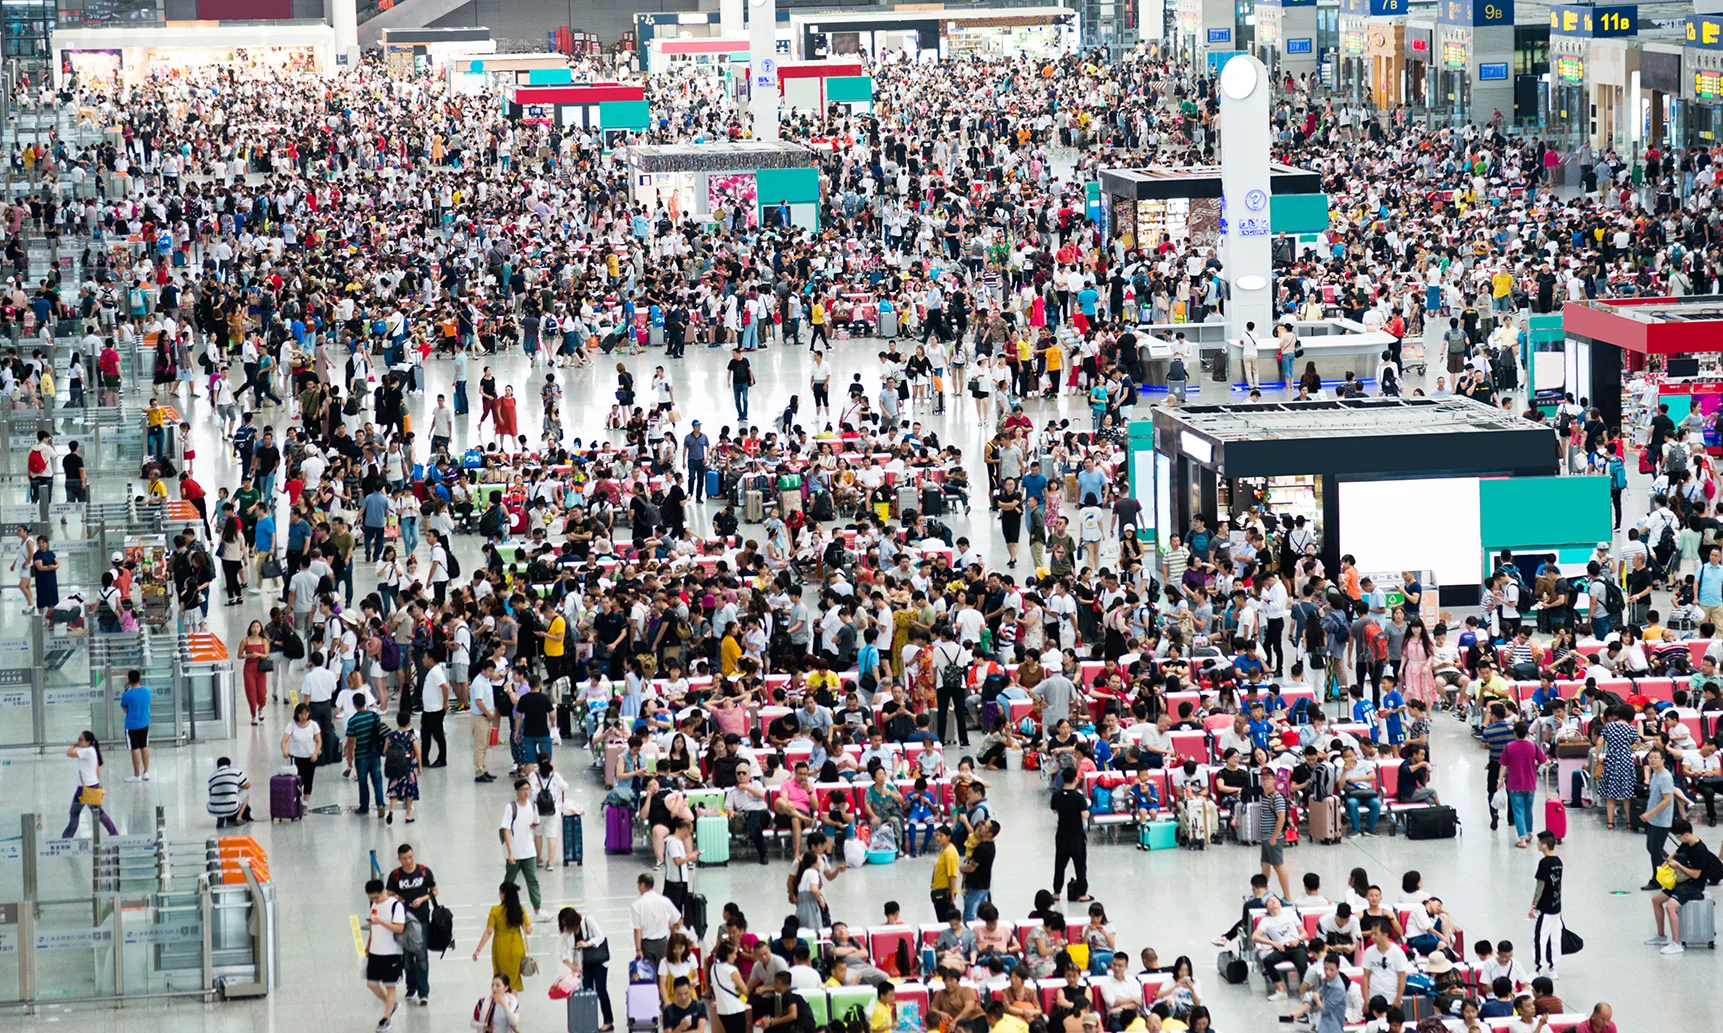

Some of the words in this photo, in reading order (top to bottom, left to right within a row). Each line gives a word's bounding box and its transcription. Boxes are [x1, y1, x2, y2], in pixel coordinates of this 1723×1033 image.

[1485, 4, 1503, 19] 9B
[1600, 12, 1630, 31] 11B
[1364, 709, 1378, 729] 15
